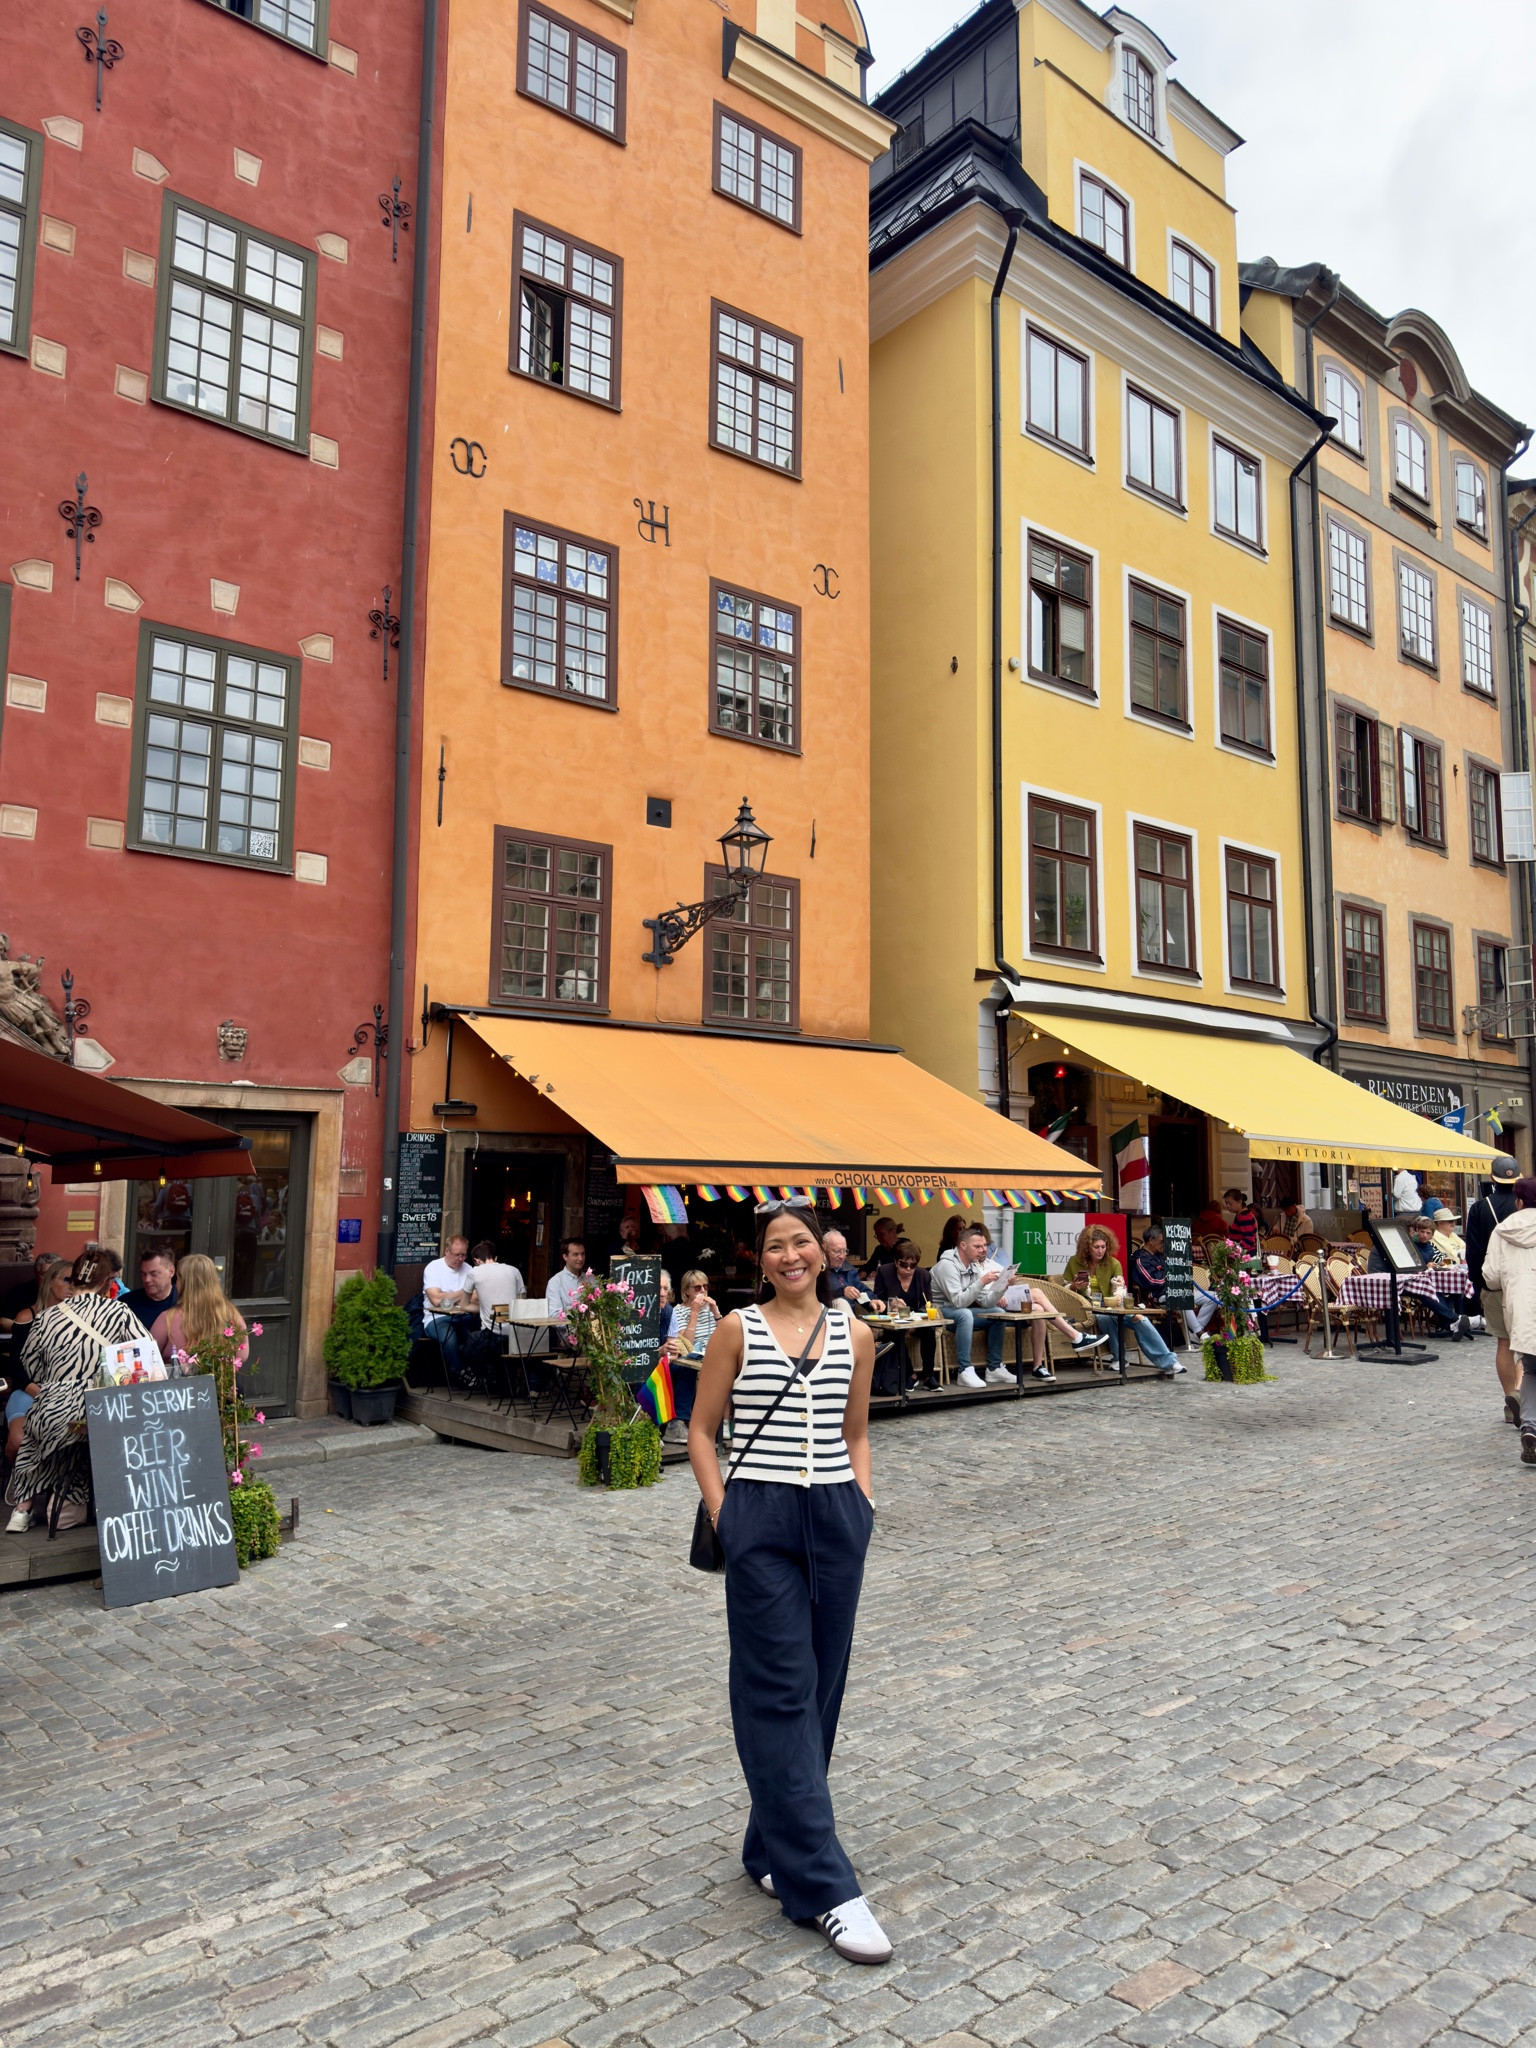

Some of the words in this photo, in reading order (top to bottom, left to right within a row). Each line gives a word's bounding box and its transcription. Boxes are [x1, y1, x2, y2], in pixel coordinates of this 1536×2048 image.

[1368, 1079, 1445, 1103] RUNSTENEN
[406, 1132, 436, 1143] DRINKS
[1277, 1146, 1352, 1161] TRATTORIA
[1437, 1158, 1486, 1170] PIZZERIA
[402, 1212, 437, 1222] SWEETS
[614, 1263, 655, 1285] TAKE
[104, 1393, 137, 1423] WE
[142, 1387, 195, 1417] SERVE
[123, 1428, 190, 1470] BEER
[125, 1462, 196, 1511] WINE
[102, 1509, 162, 1563] COFFEE
[164, 1501, 233, 1553] DRINKS
